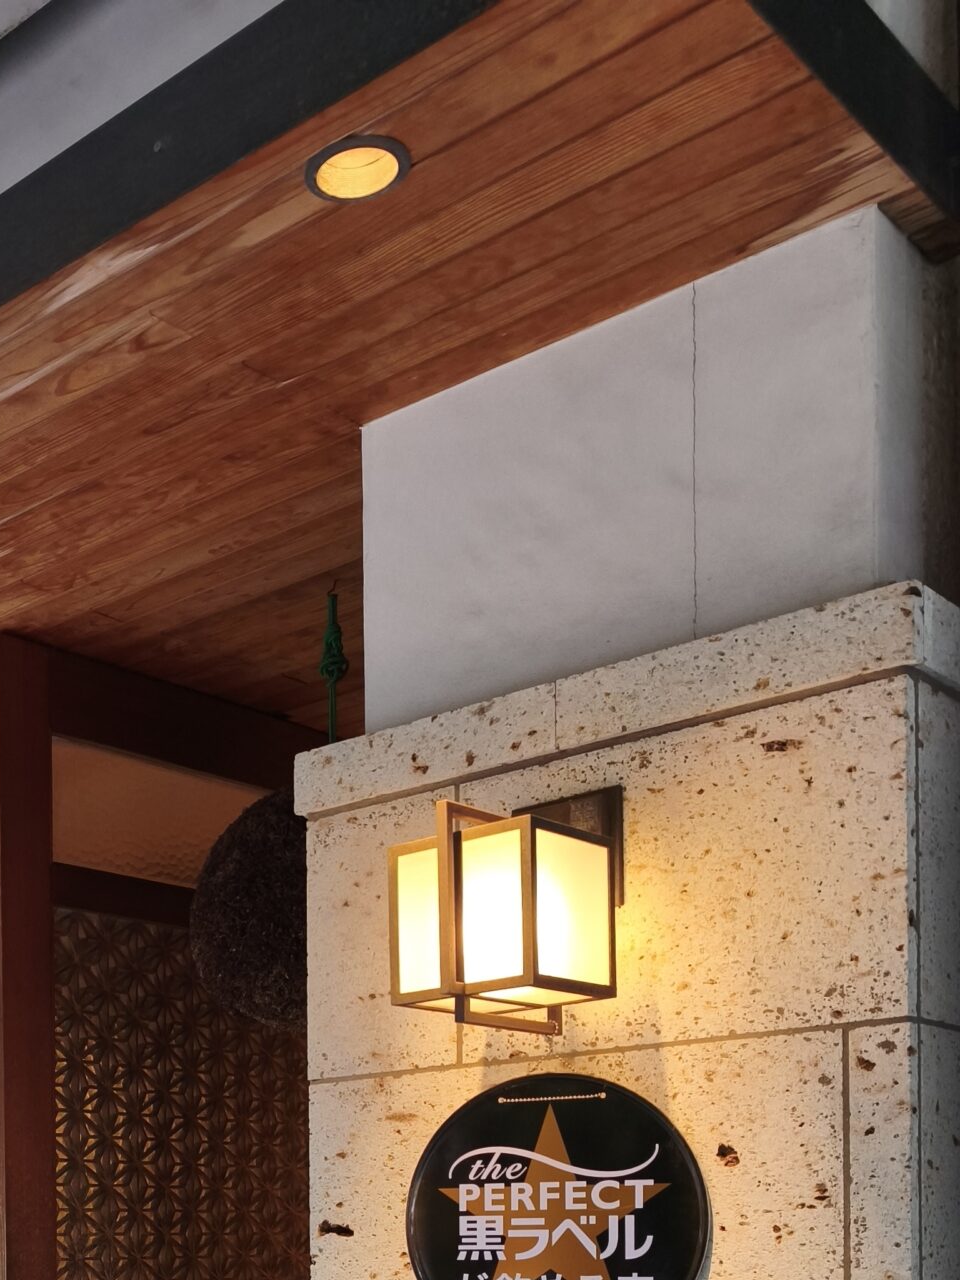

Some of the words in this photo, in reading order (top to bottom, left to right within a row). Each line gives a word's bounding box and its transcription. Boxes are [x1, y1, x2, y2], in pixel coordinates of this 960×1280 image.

[468, 1151, 528, 1181] the
[457, 1179, 655, 1212] PERFECT
[456, 1214, 654, 1261] 黒ラベル
